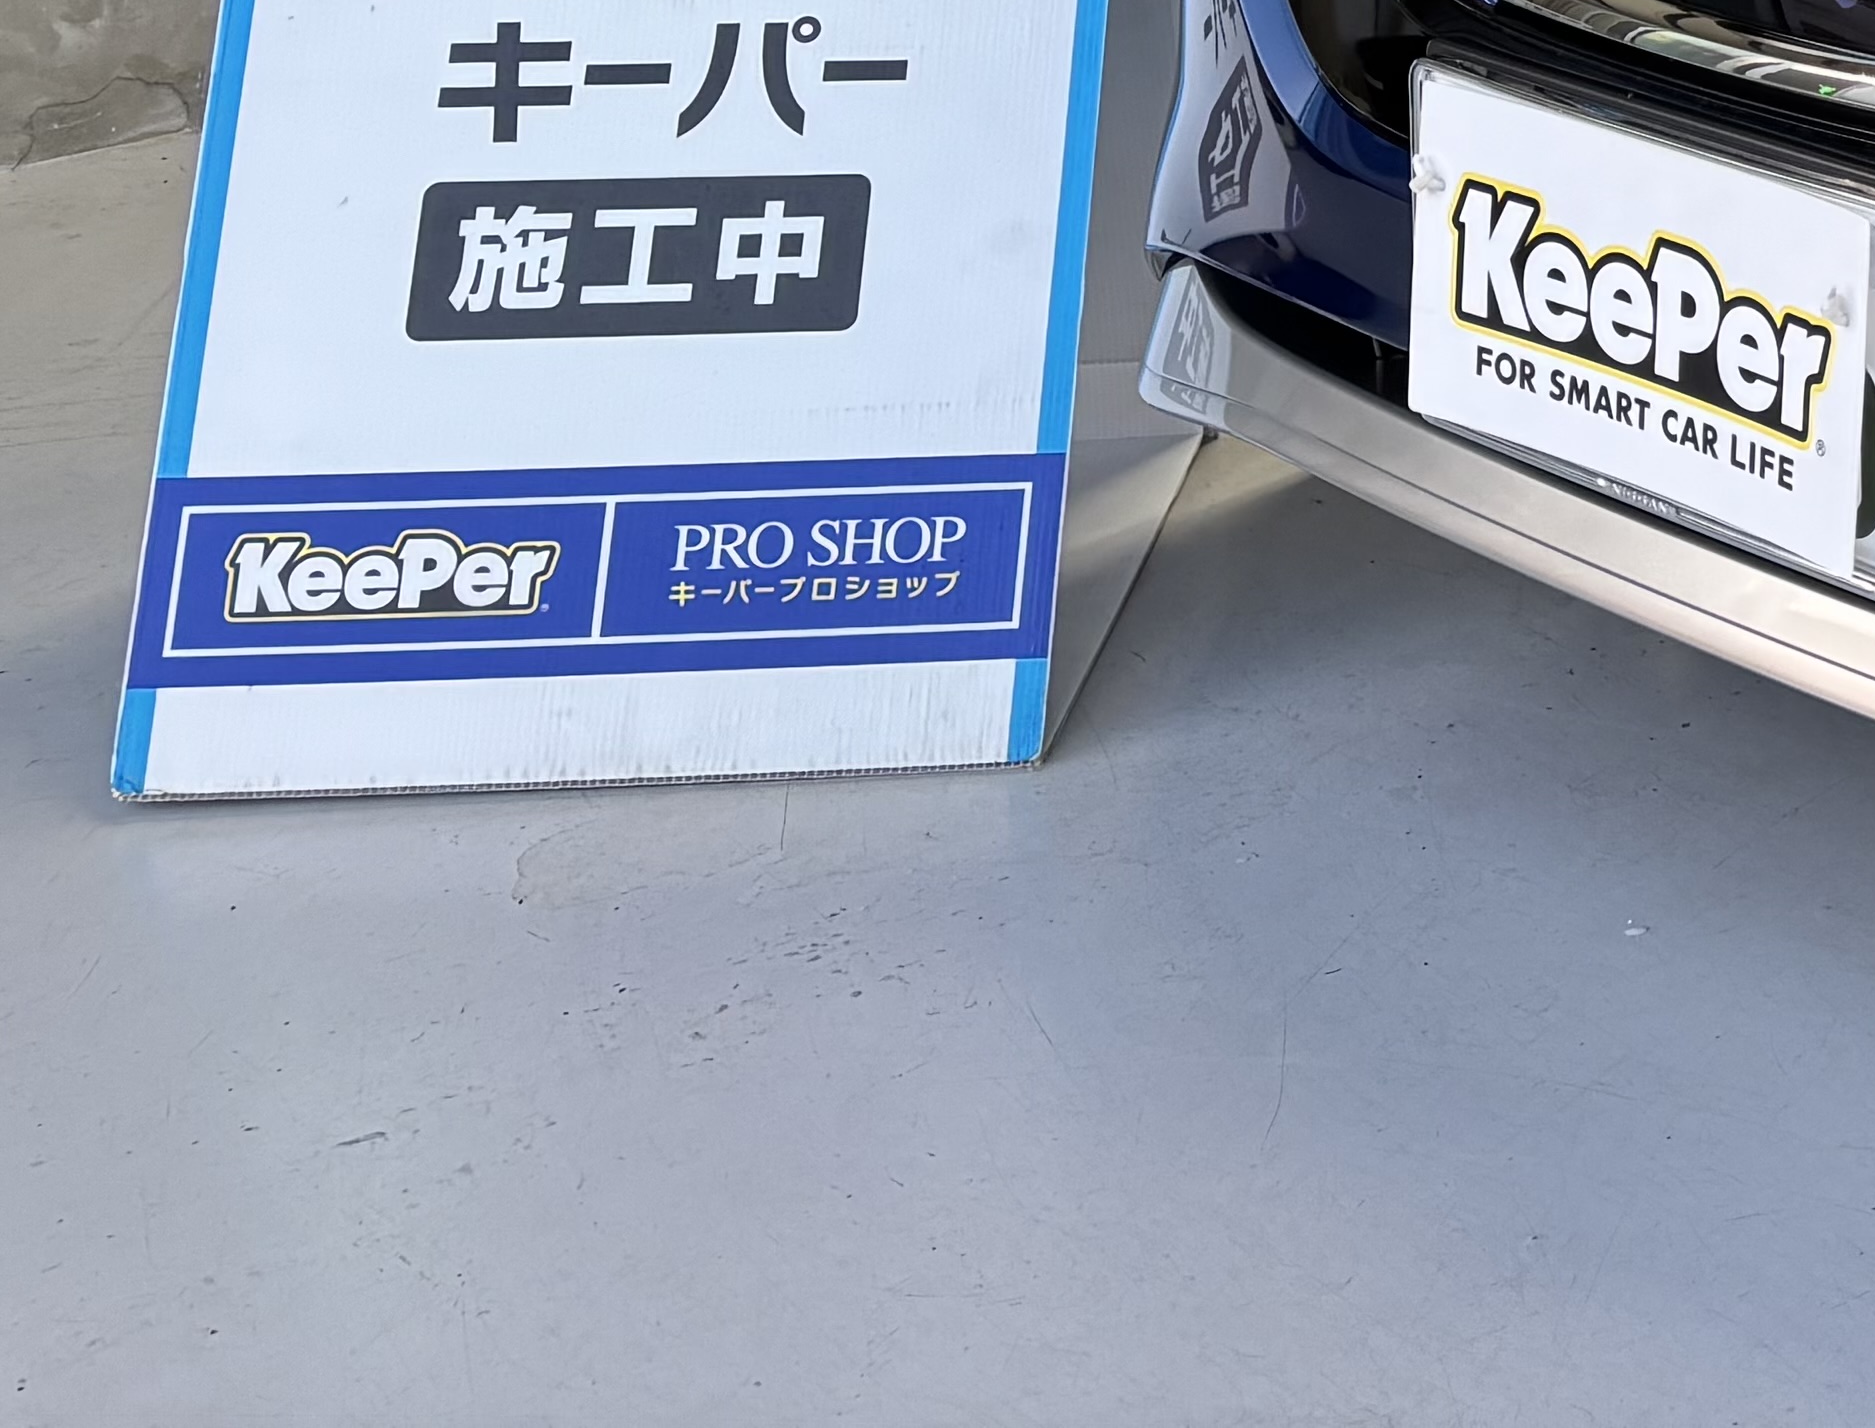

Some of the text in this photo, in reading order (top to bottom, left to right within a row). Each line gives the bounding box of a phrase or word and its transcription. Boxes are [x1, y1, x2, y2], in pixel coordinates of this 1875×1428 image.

[437, 16, 908, 143] キーパー
[448, 200, 825, 312] 施工中
[1459, 187, 1826, 432] KeePer
[1476, 345, 1795, 492] FOR SMART CAR LIFE
[233, 538, 550, 614] KeePer
[668, 570, 961, 607] キーパープロショップ
[670, 516, 967, 571] PRO SHOP
